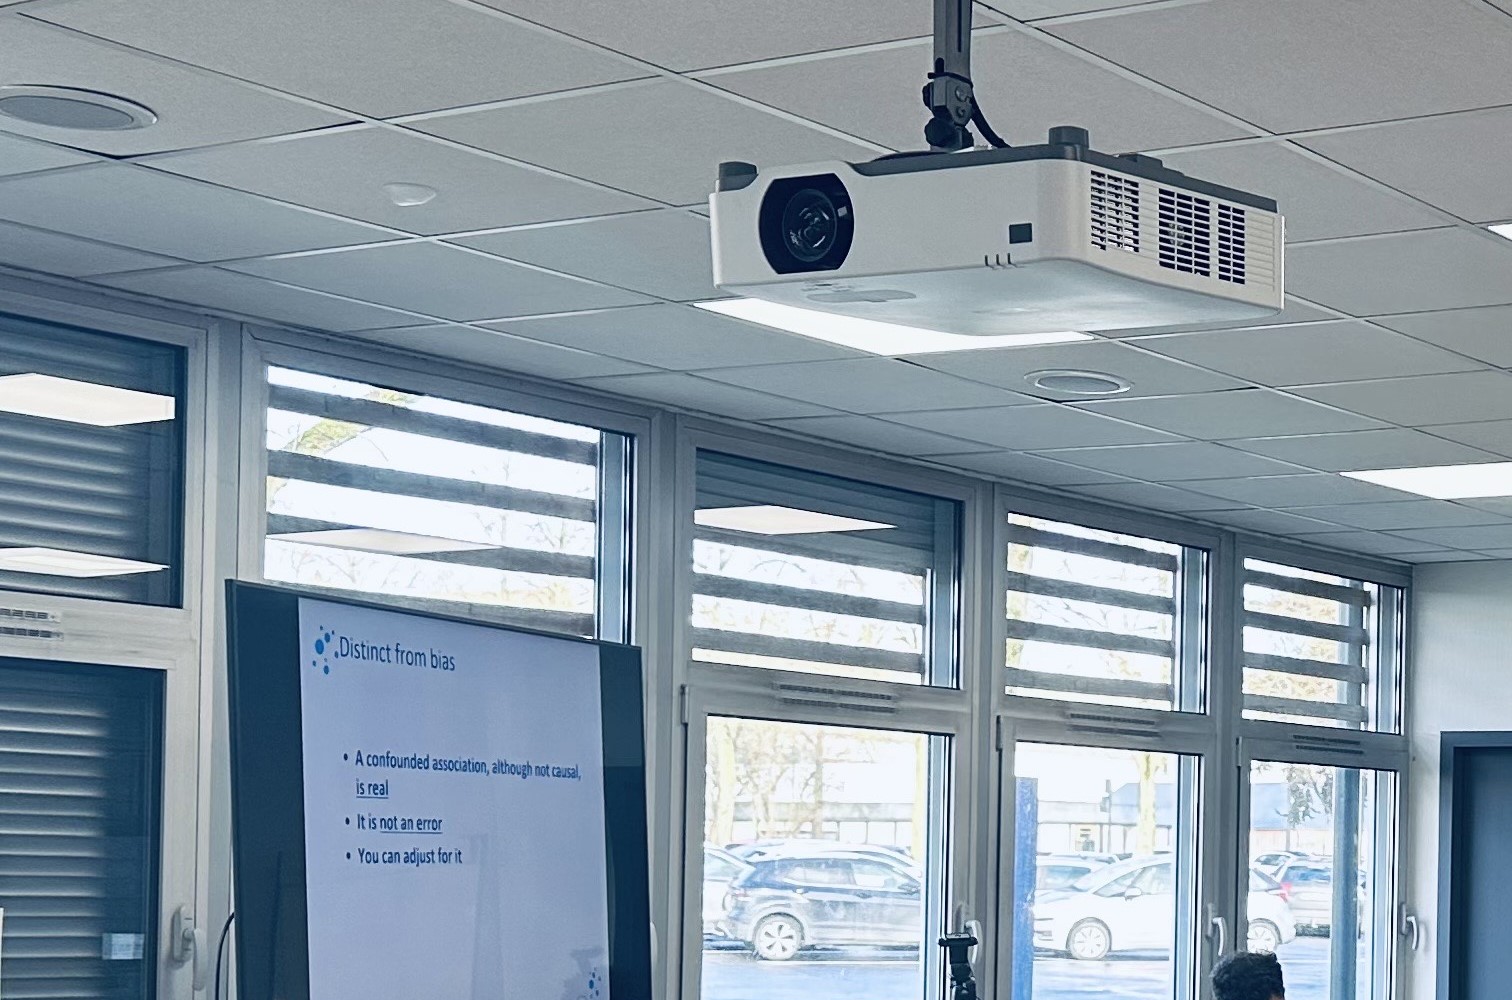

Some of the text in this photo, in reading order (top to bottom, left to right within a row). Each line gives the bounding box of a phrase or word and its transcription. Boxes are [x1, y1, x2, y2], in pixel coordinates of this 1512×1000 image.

[340, 636, 455, 671] Distinct from bias
[355, 750, 581, 781] A confounded association, although not causal,
[356, 778, 389, 796] is real
[357, 813, 443, 831] It is not an error
[358, 846, 463, 867] You can adjust for it
